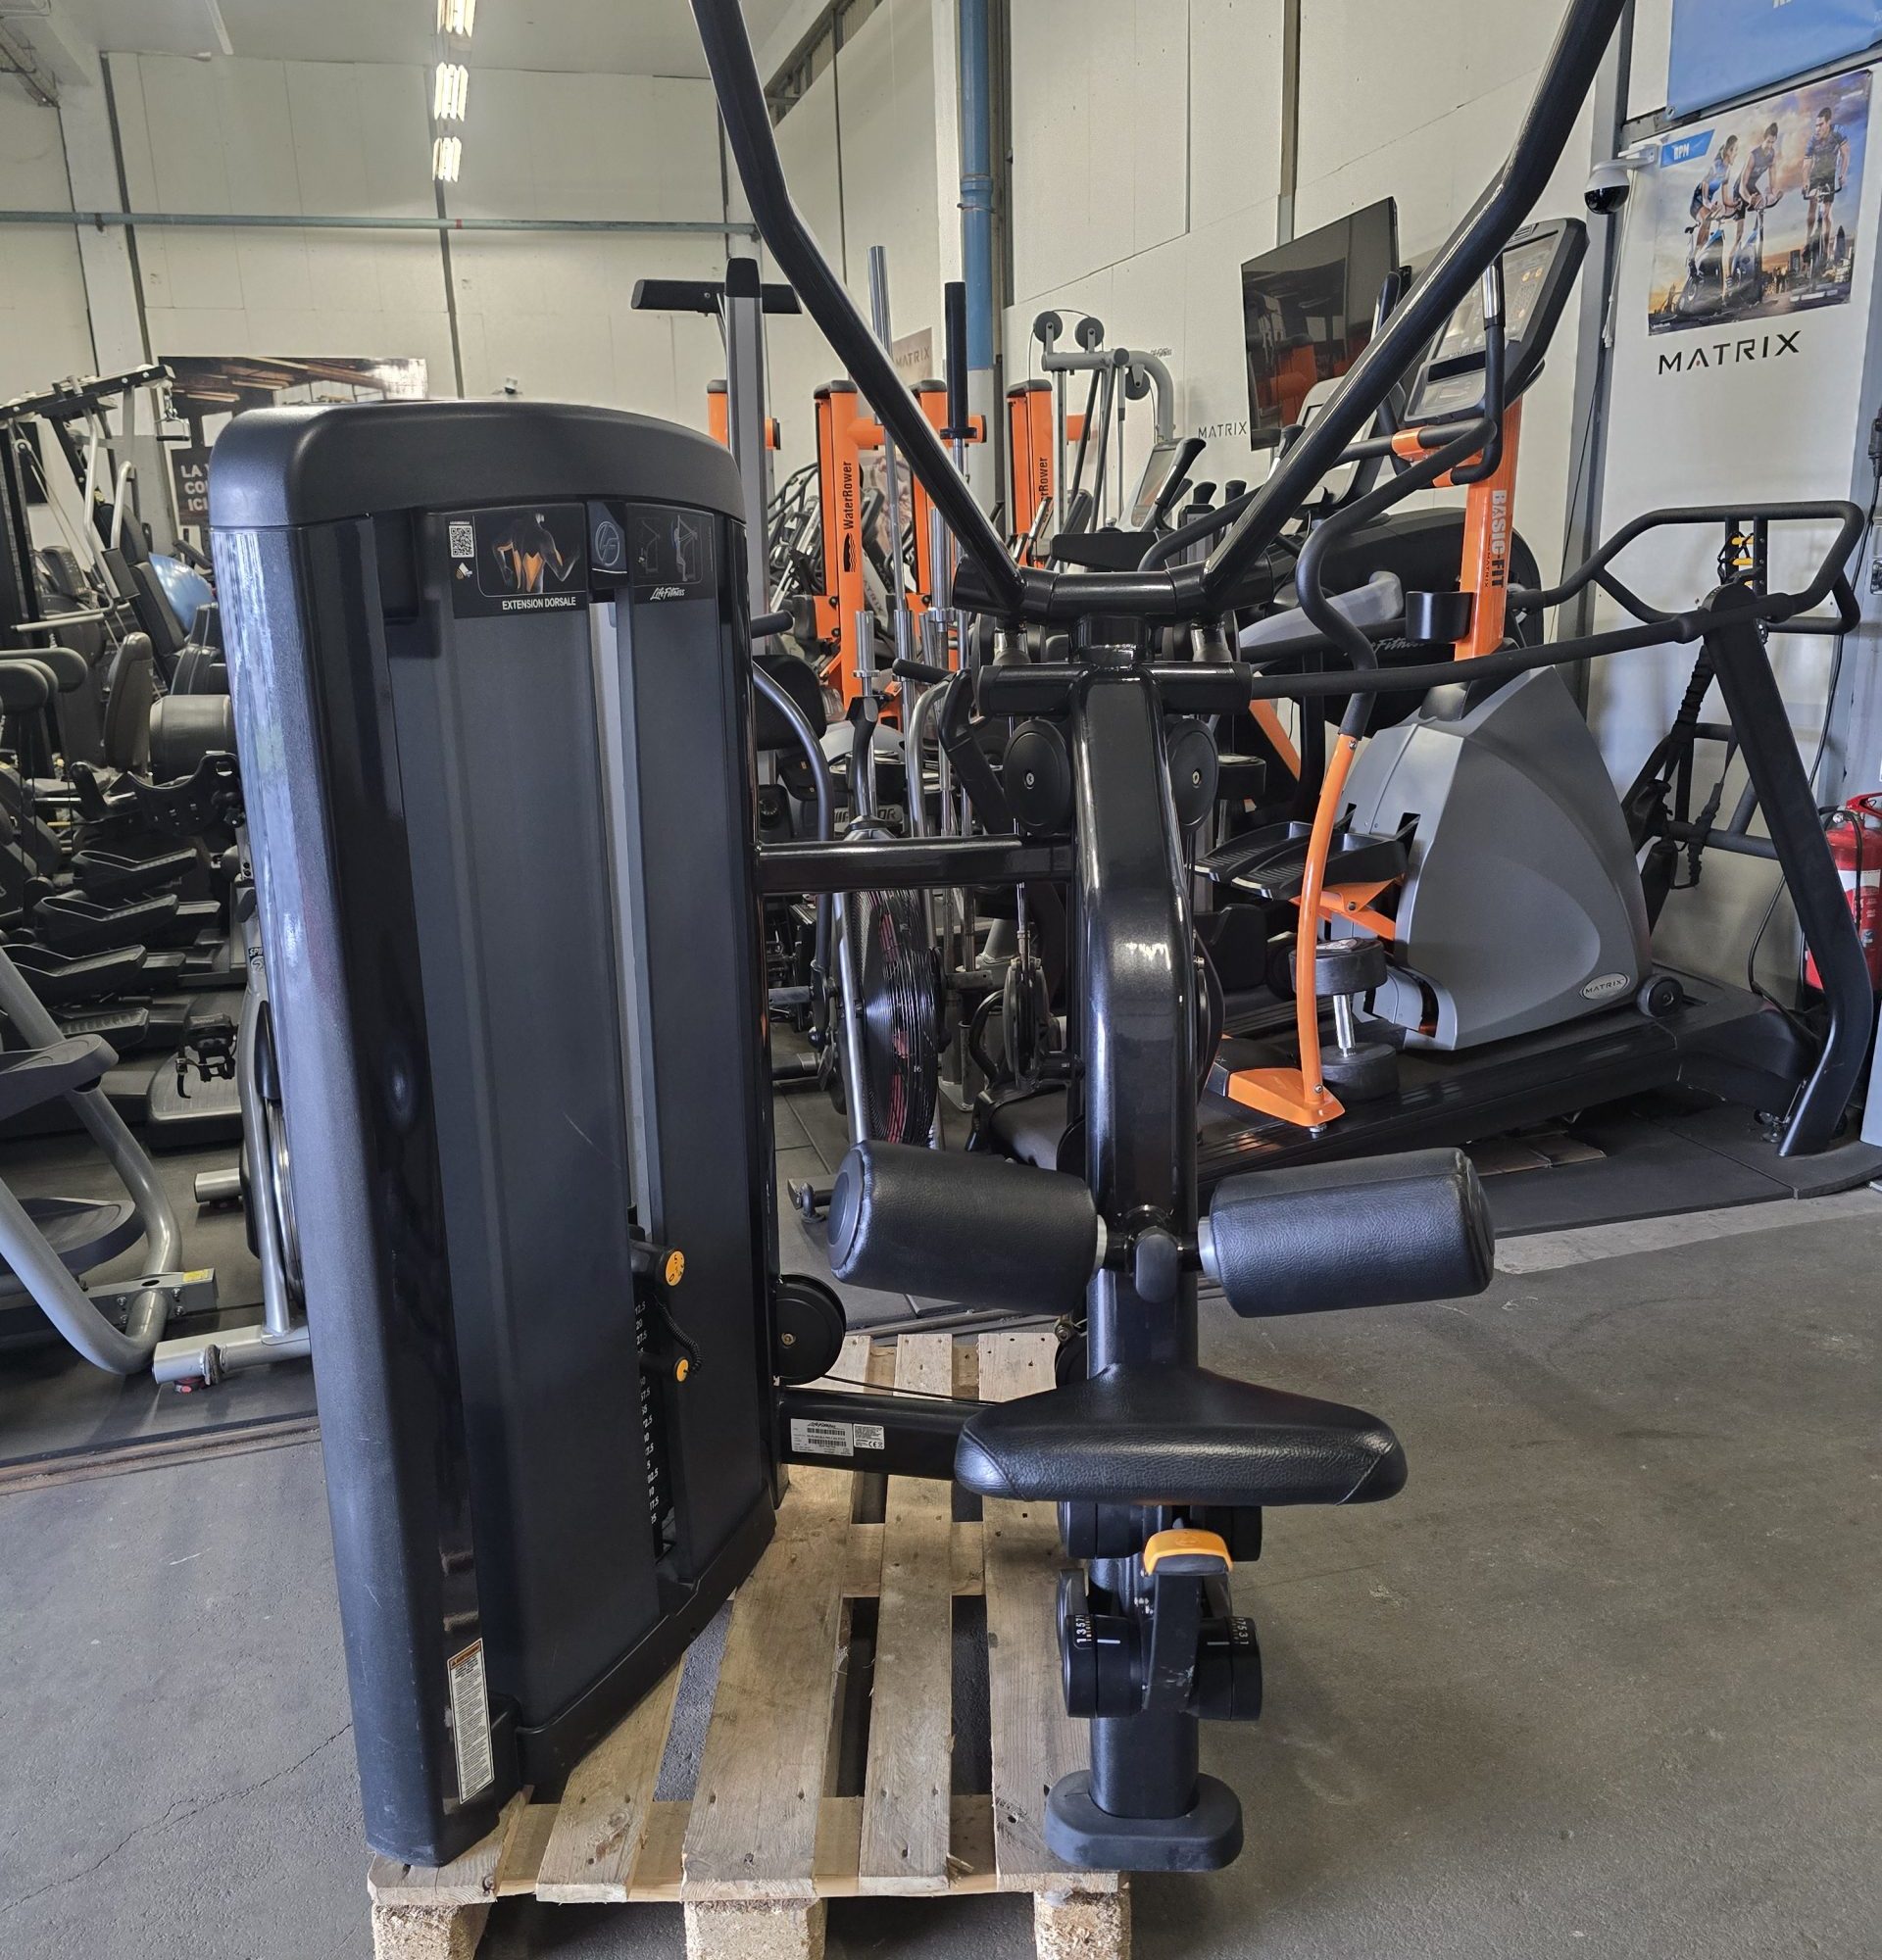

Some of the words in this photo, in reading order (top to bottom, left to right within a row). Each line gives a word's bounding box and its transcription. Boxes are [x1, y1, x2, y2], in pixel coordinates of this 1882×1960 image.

[895, 345, 931, 368] MATRIX
[1658, 330, 1802, 375] MATRIX
[1198, 421, 1247, 439] MATRIX
[180, 464, 203, 478] LA
[1039, 457, 1049, 503] rRower
[184, 480, 209, 495] CO
[843, 461, 854, 530] WaterRower
[1492, 490, 1507, 588] BASIC-FIT
[502, 599, 543, 611] EXTENSION
[545, 597, 576, 607] DORSALE
[1584, 980, 1621, 995] MATRIX
